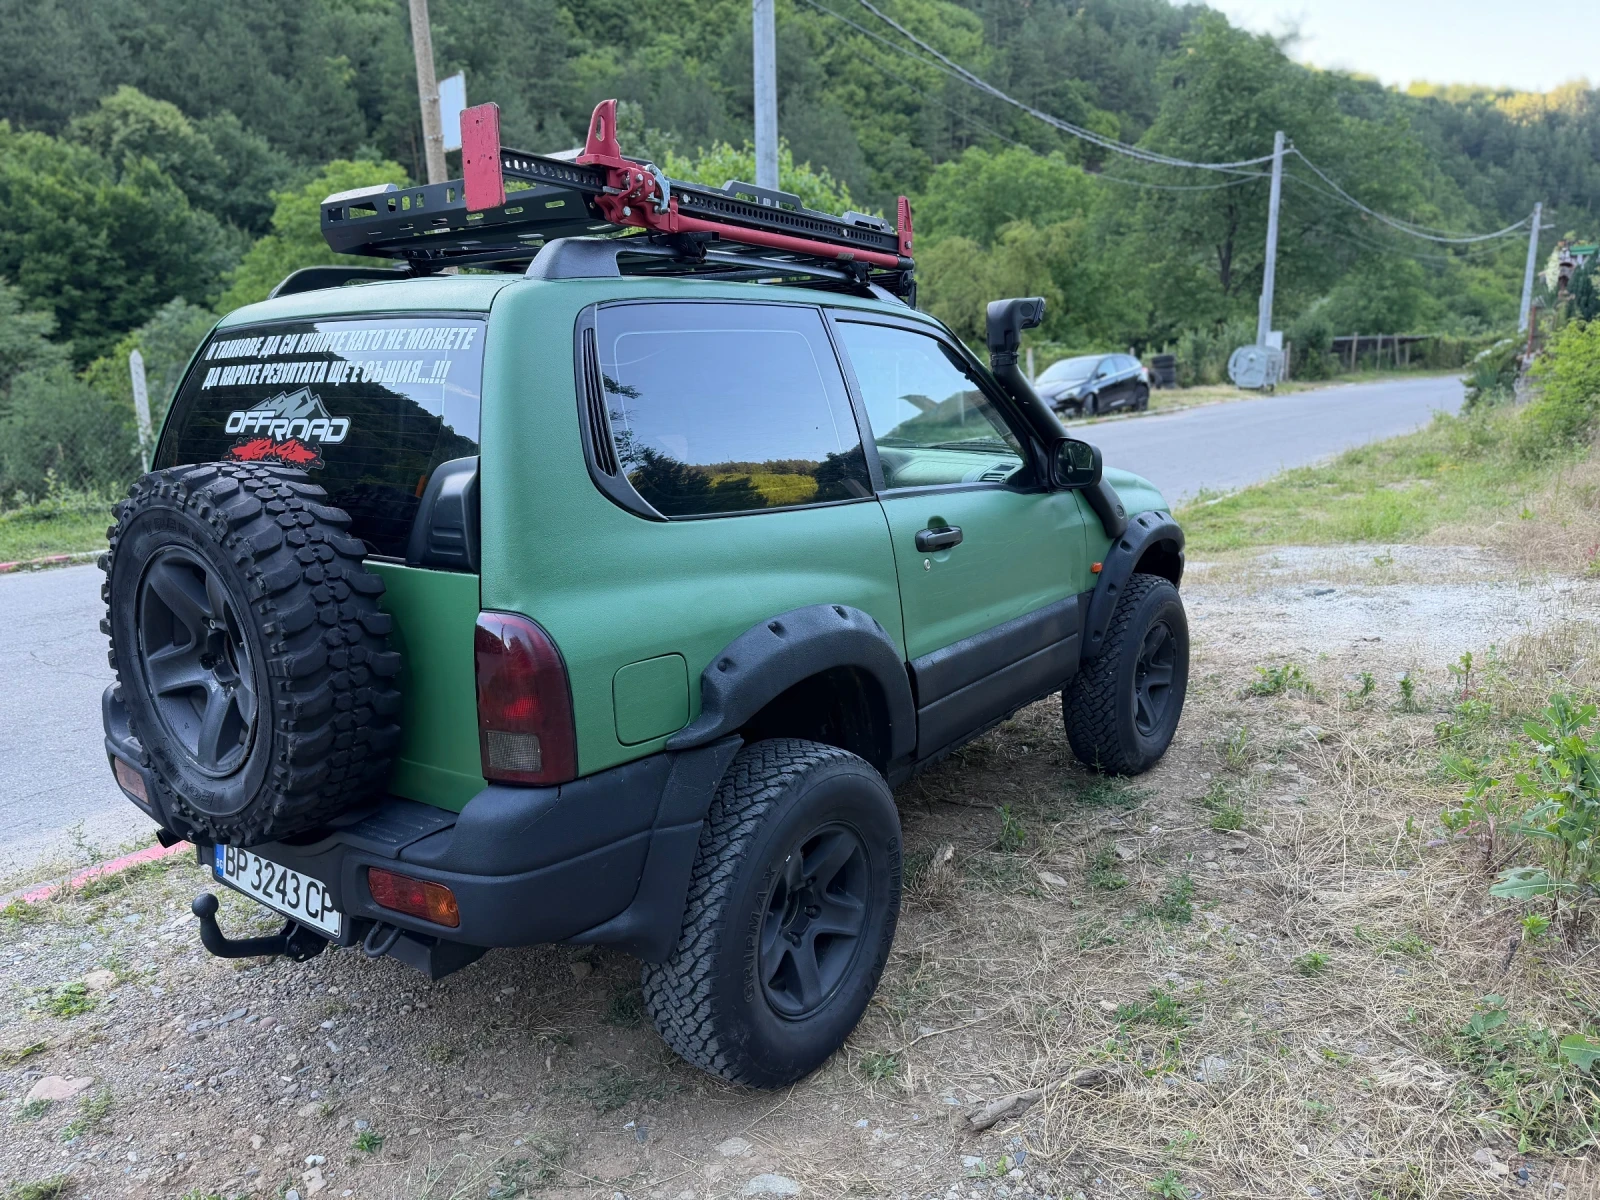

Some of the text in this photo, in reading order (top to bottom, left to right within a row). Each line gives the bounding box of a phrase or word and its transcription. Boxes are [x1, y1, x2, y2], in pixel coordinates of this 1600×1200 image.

[201, 367, 221, 390] ДА
[219, 364, 262, 386] КАРАТЕ
[258, 361, 328, 384] РЕЗУЛТАТА
[326, 360, 353, 386] ЩЕ
[349, 360, 364, 383] Е
[205, 327, 478, 360] И ТАНКОВЕ ДА СИ КУПИТЕ КАТО НЕ МОЖЕТЕ
[225, 847, 336, 922] BP 3243 CP
[881, 836, 901, 947] GRIPMAX
[743, 862, 777, 1003] GRIPMAX
